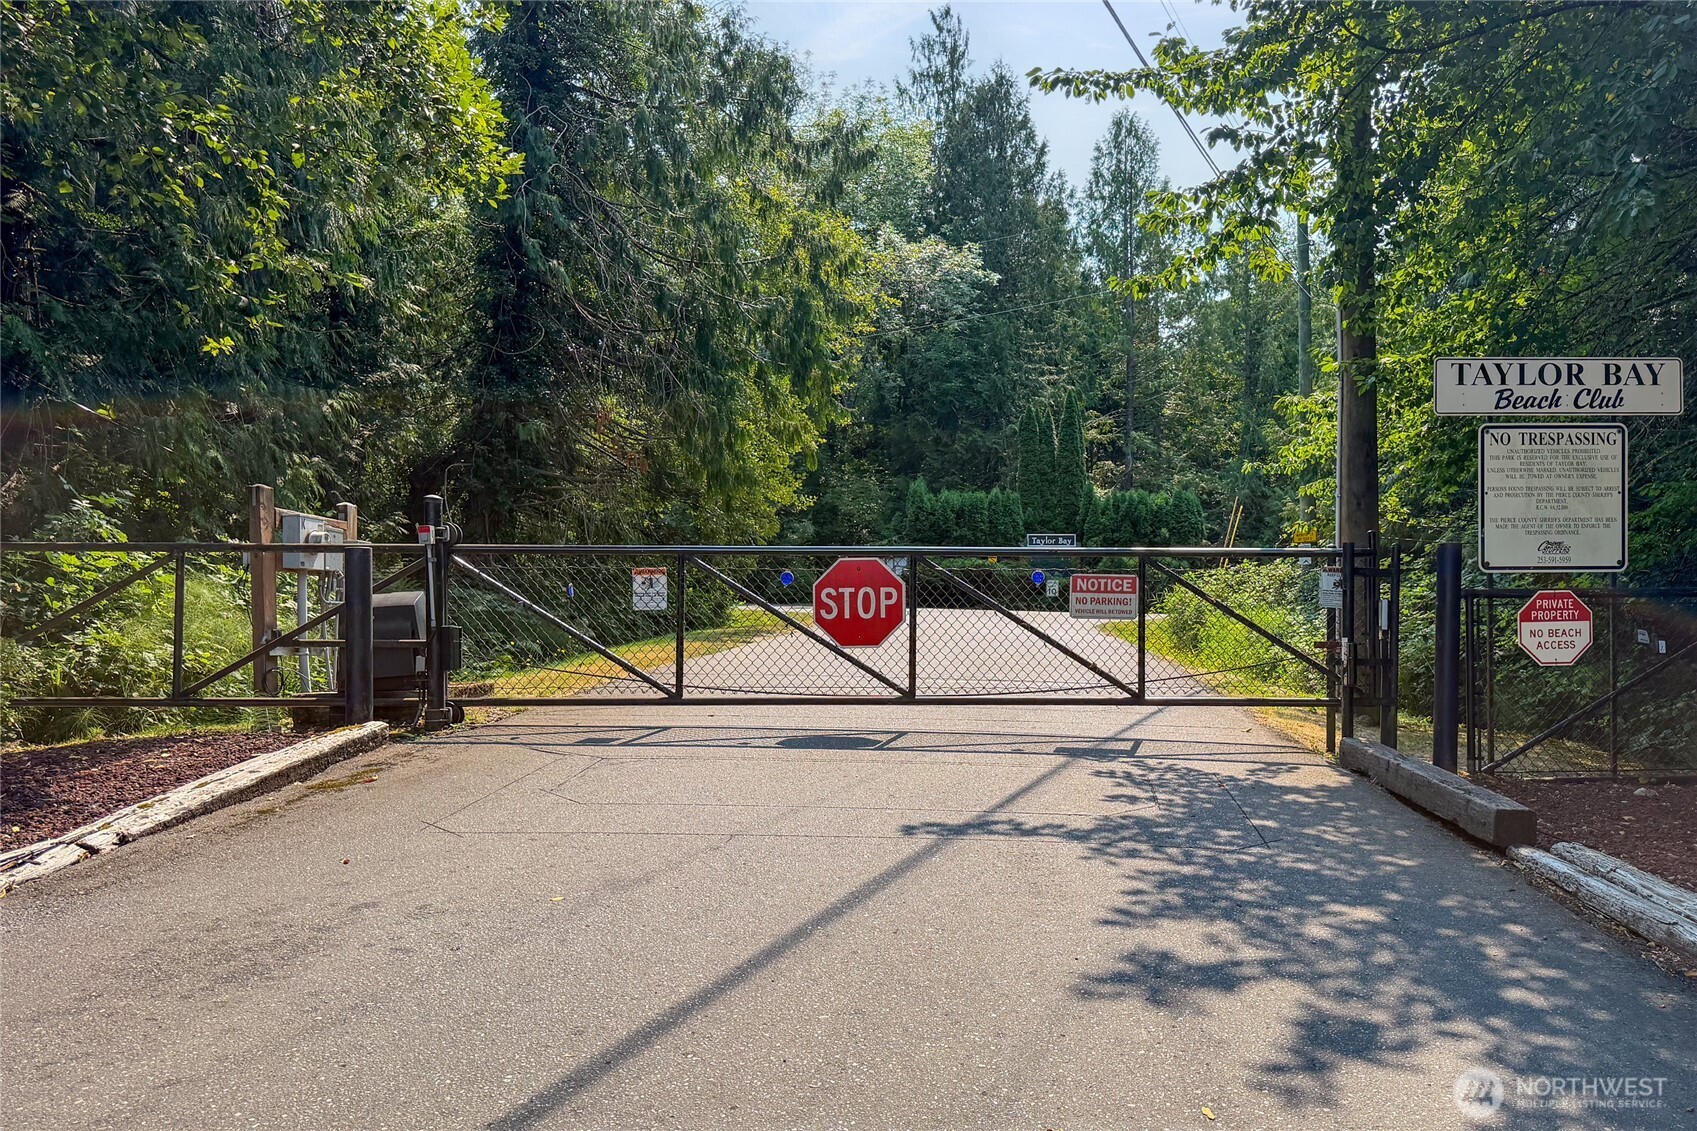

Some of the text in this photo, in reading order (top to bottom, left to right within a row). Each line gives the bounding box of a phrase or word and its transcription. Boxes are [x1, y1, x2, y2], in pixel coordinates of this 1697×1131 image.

[1451, 363, 1666, 386] TAYLOR BAY
[1494, 388, 1624, 410] Beach Club
[1490, 432, 1617, 446] NO TRESPASSING
[1032, 536, 1072, 546] Taylor Bay
[1076, 578, 1132, 592] NOTICE
[820, 586, 898, 620] STOP
[1075, 597, 1132, 606] NO PARKING!
[1536, 599, 1574, 609] PRIVATE
[1531, 610, 1579, 620] PROPERTY
[1530, 628, 1582, 638] NO BEACH
[1536, 640, 1576, 650] ACCESS
